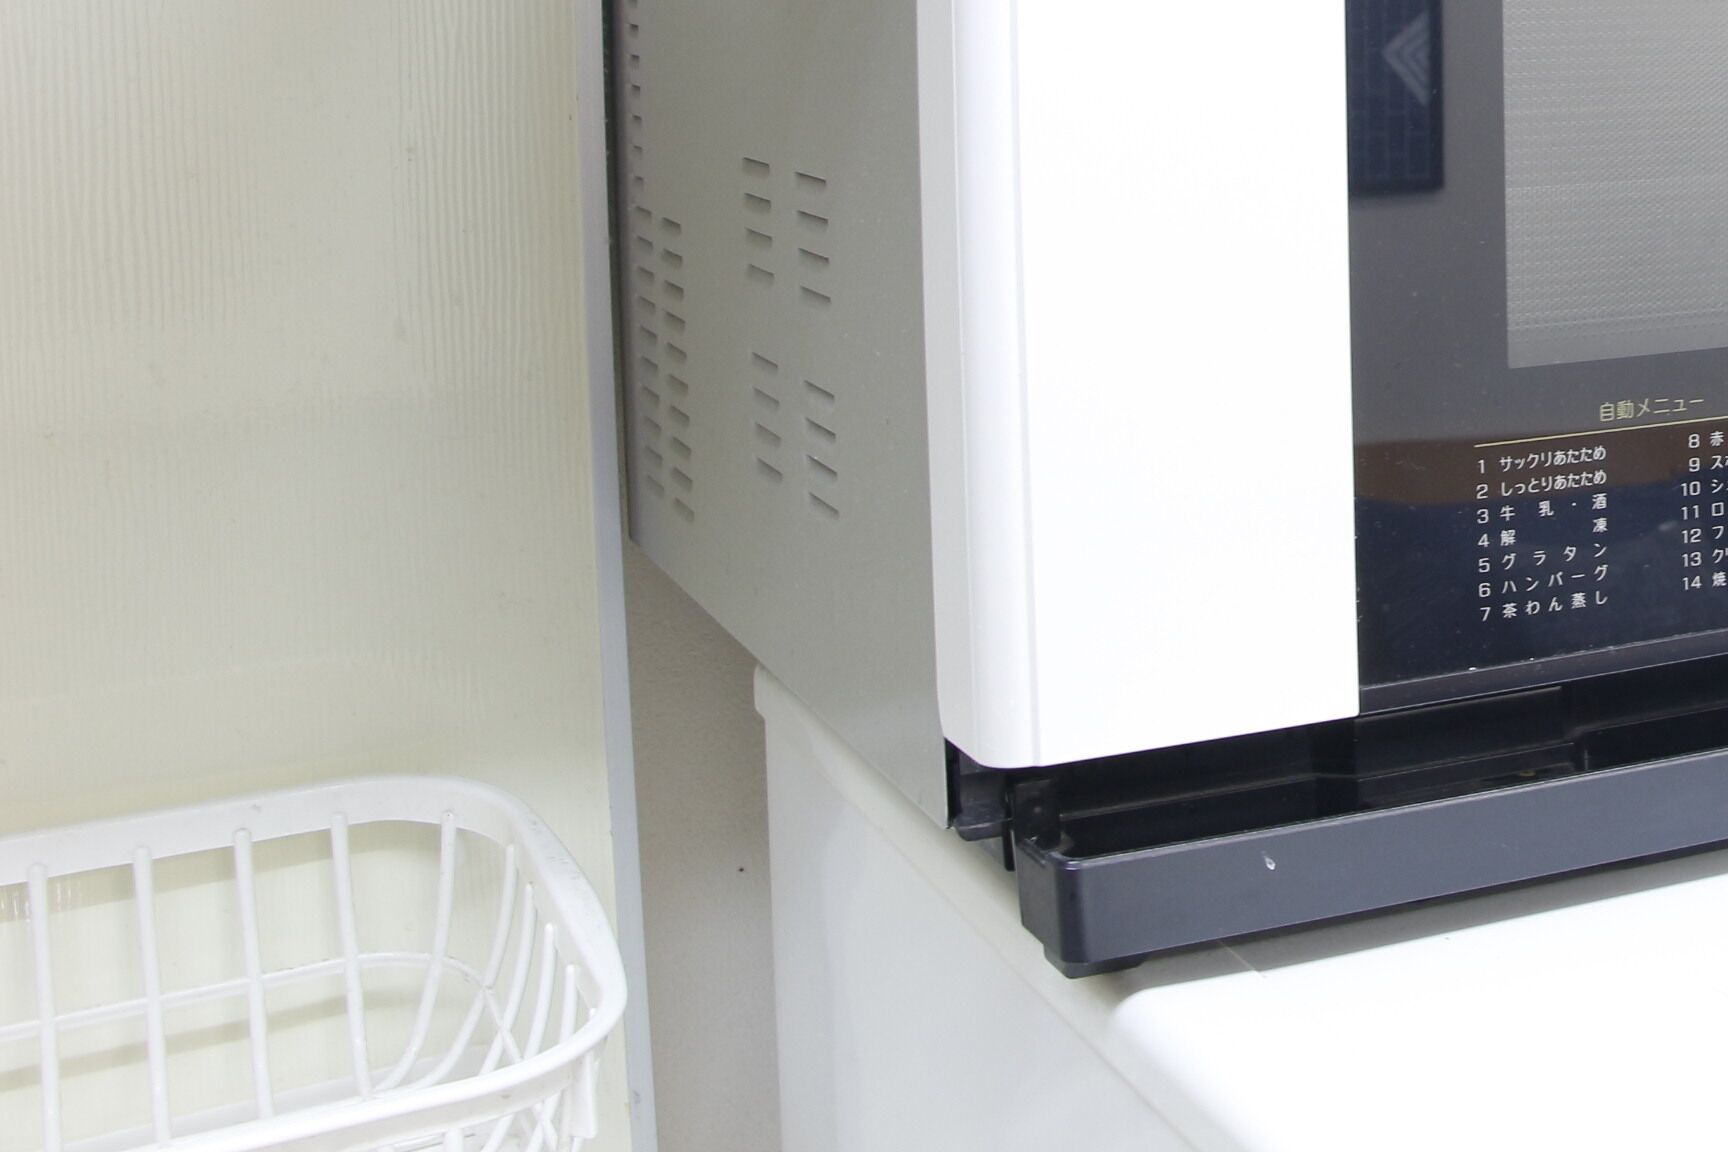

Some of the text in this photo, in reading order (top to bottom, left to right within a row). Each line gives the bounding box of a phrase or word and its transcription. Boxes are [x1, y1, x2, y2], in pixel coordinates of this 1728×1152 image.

[1599, 398, 1704, 423] 自動メニュー
[1687, 434, 1700, 449] 8
[1477, 446, 1607, 474] 1 サックリあたため
[1687, 457, 1701, 472] 9
[1475, 470, 1607, 499] 2 しっとりあたため
[1680, 481, 1701, 497] 10
[1476, 509, 1490, 524] 3
[1681, 505, 1700, 520] 11
[1477, 518, 1609, 547] 4 解凍
[1681, 530, 1702, 544] 12
[1477, 544, 1608, 573] 5 グラタン
[1681, 553, 1702, 568] 13
[1478, 566, 1609, 598] 6 ハンバーグ
[1682, 576, 1702, 591] 14
[1479, 591, 1609, 621] 7 茶わん蒸し
